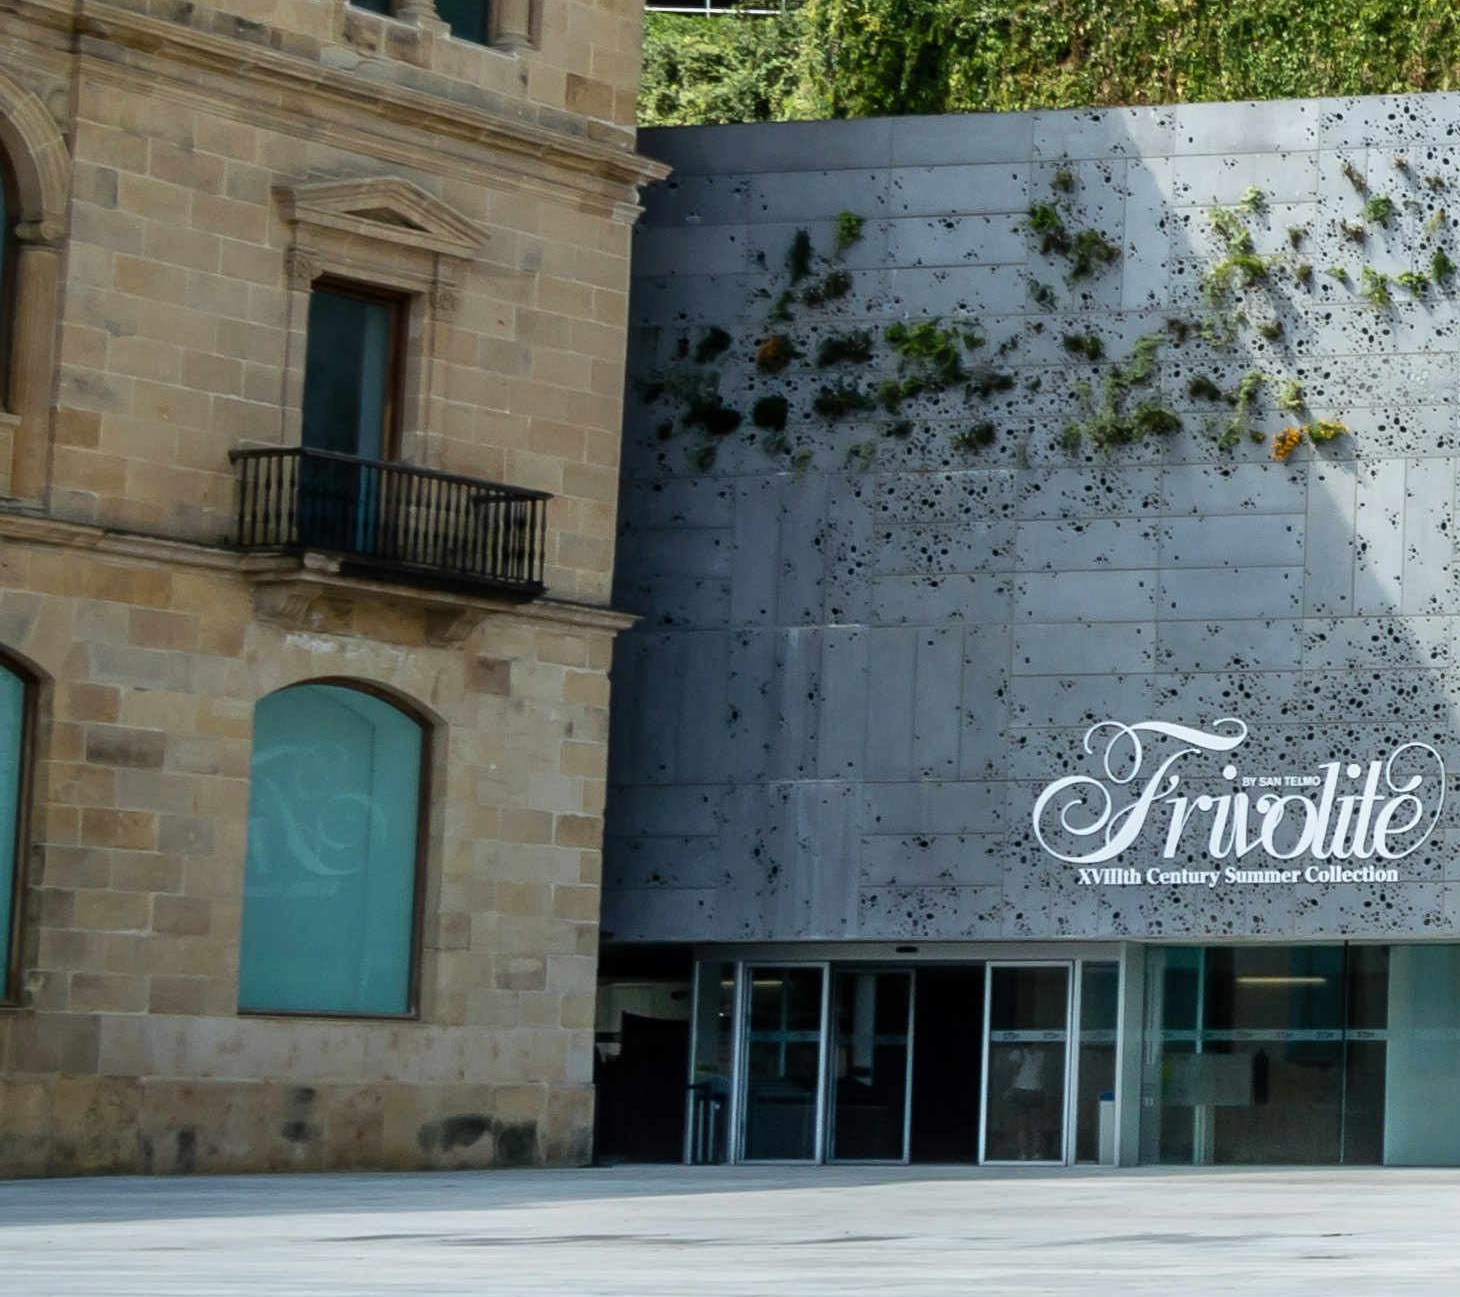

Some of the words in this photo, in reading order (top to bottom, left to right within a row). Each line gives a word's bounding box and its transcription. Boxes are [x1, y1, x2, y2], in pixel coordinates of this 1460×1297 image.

[1242, 776, 1257, 786] BY
[1258, 775, 1282, 787] SAN
[1283, 775, 1321, 787] TELMO
[1078, 868, 1142, 885] XVIIIth
[1146, 868, 1221, 887] Century
[1224, 867, 1301, 884] Summer
[1304, 866, 1398, 882] Collection
